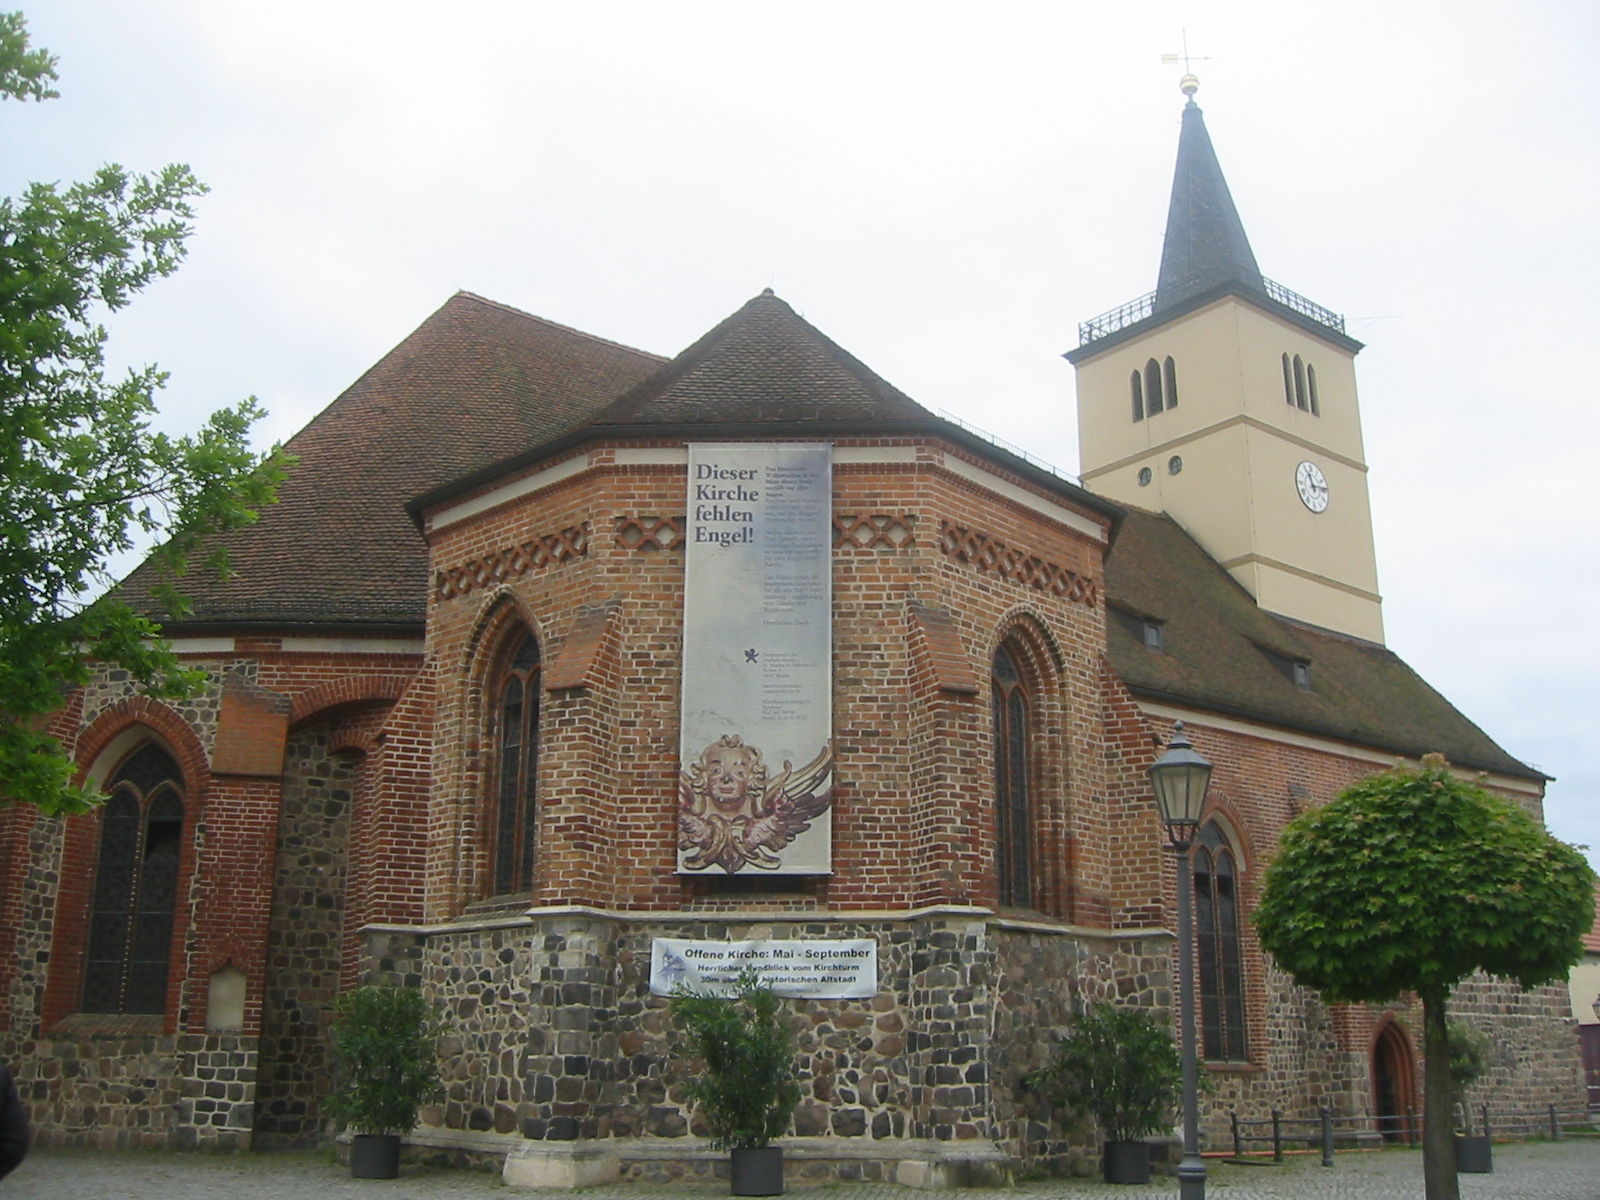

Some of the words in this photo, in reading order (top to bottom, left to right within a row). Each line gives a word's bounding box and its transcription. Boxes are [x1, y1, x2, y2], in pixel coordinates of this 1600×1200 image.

[697, 464, 758, 480] Dieser
[696, 484, 759, 502] Kirche
[695, 504, 753, 522] fehlen
[695, 526, 753, 548] Engel!
[684, 948, 724, 960] Offene
[727, 949, 769, 960] Kirche:
[773, 949, 794, 959] Mai
[805, 948, 870, 960] September
[697, 964, 742, 972] Herrlicher
[745, 964, 790, 972] undblick
[814, 963, 860, 972] Kirchturm
[701, 975, 720, 983] 30m
[820, 975, 857, 983] Altstadt
